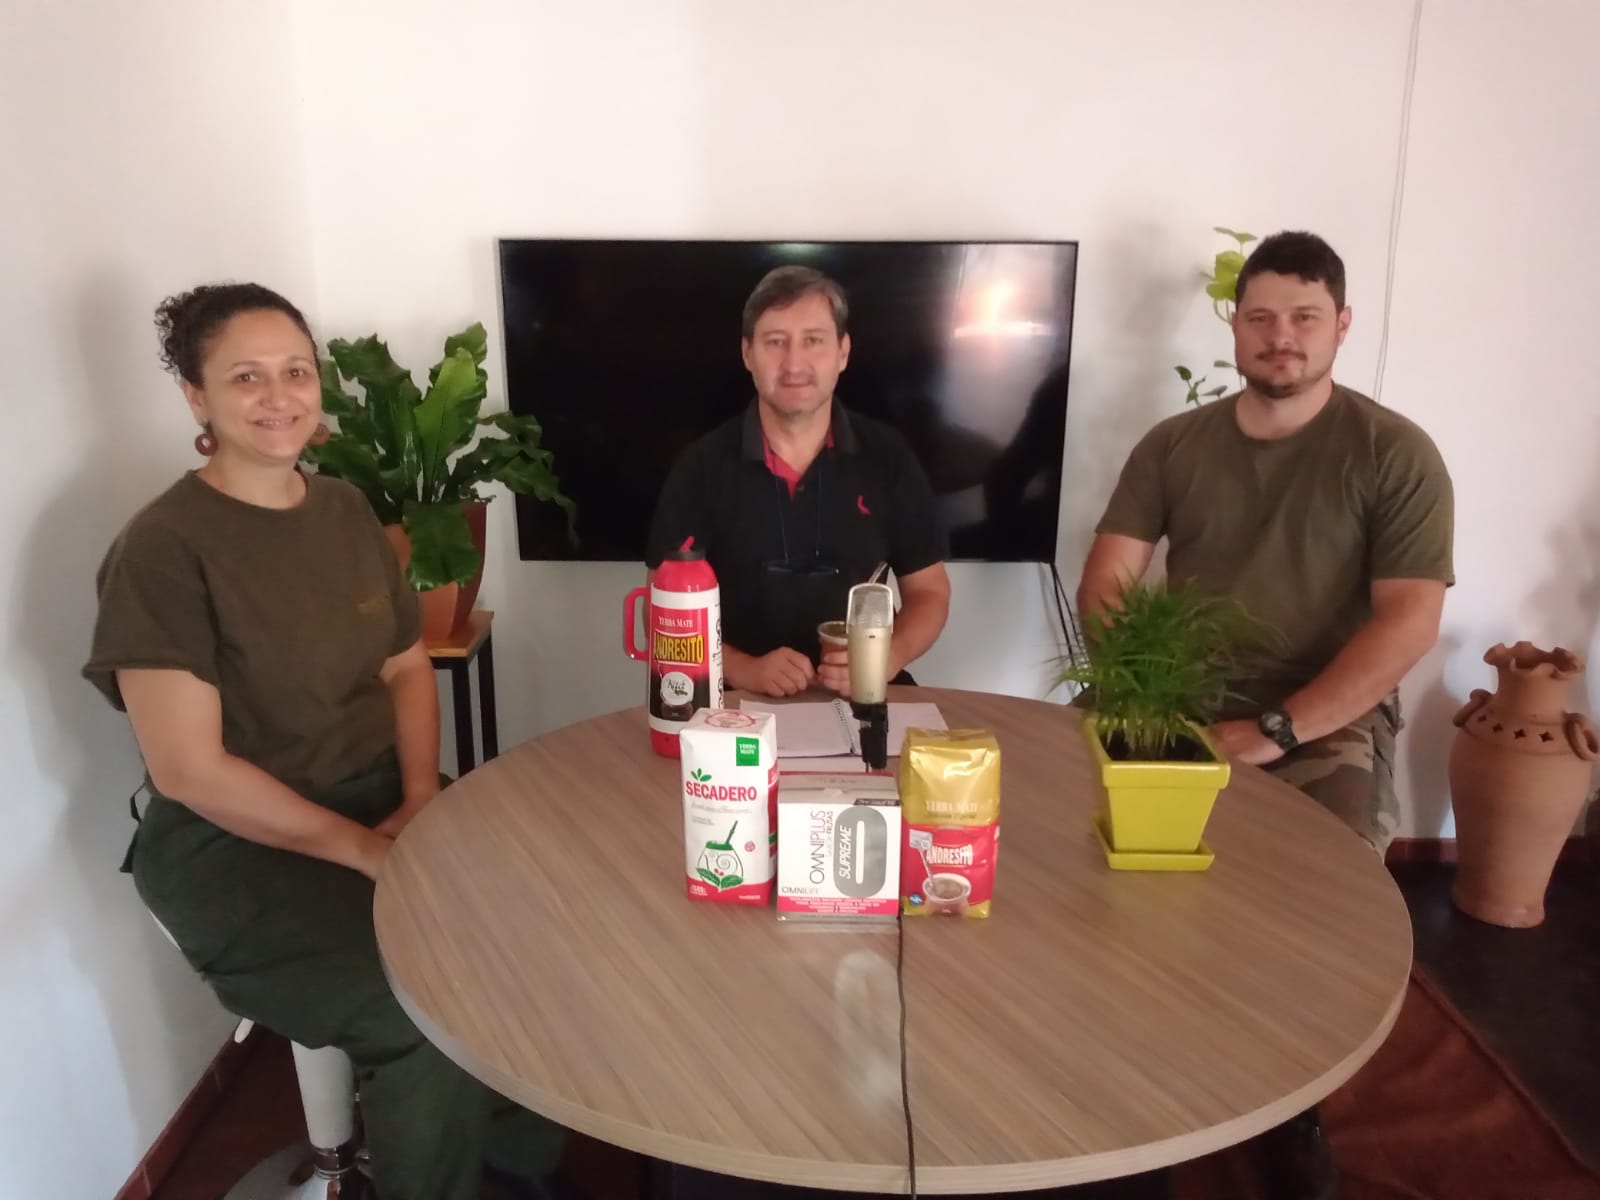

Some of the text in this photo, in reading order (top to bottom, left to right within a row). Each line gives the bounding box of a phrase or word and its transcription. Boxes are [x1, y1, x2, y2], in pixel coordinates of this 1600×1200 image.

[658, 616, 694, 628] YERBA MATE
[654, 634, 704, 664] ANDRESITO
[685, 780, 758, 802] SECADERO
[809, 810, 826, 884] OMNIPLUS
[839, 825, 852, 880] SUPREME
[926, 844, 973, 866] ANDRESITO
